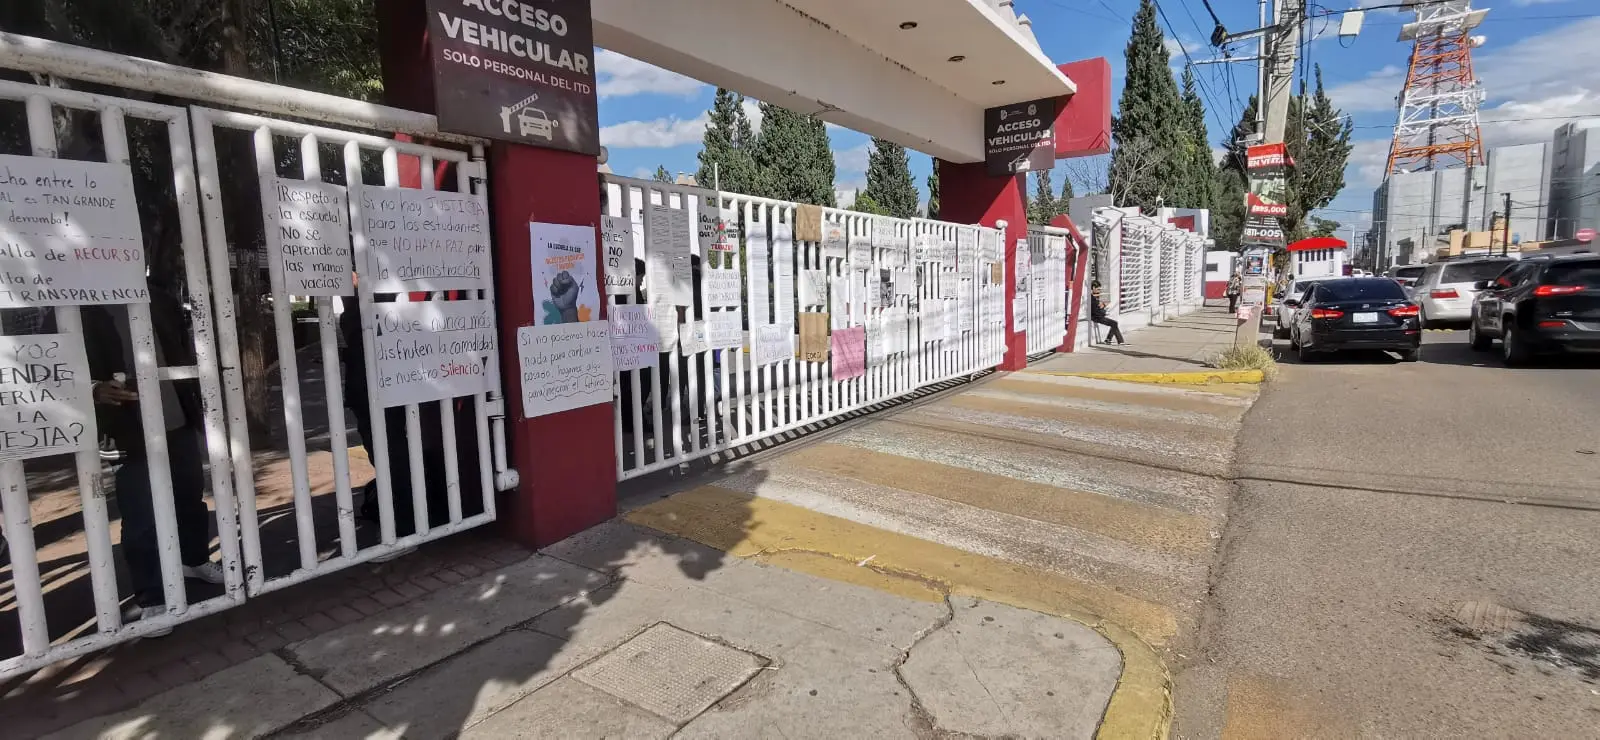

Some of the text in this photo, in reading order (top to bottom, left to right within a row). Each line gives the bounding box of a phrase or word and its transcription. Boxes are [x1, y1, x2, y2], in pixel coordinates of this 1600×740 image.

[438, 12, 589, 75] VEHICULAR
[443, 49, 591, 95] SOLO PERSONAL DEL ITD
[996, 118, 1041, 134] ACCESO
[988, 129, 1052, 146] VEHICULAR
[35, 169, 74, 188] entre
[84, 169, 97, 189] lo
[42, 193, 70, 206] TAN
[73, 195, 117, 209] GRANDE
[363, 191, 375, 210] Si
[380, 199, 396, 212] no
[400, 191, 422, 217] hay
[279, 205, 342, 227] la escuela!
[368, 217, 396, 233] para
[402, 215, 420, 231] los
[305, 229, 321, 241] se
[44, 248, 67, 262] de
[74, 247, 141, 262] RECURSO
[282, 243, 349, 257] aprende con
[369, 236, 486, 256] que NO HAYA PAZ para
[609, 246, 623, 257] NO
[285, 259, 344, 273] las manos
[376, 256, 481, 280] la administración
[608, 257, 619, 269] ES
[33, 273, 54, 286] de
[431, 313, 466, 331] nunca
[470, 310, 492, 330] más
[520, 327, 608, 348] Si no podemos hacer
[379, 332, 494, 361] disfruten la comodidad
[524, 351, 548, 367] nada
[550, 351, 566, 365] para
[379, 367, 392, 388] de
[396, 361, 438, 384] nuestro
[528, 391, 544, 404] para
[17, 410, 48, 424] LA
